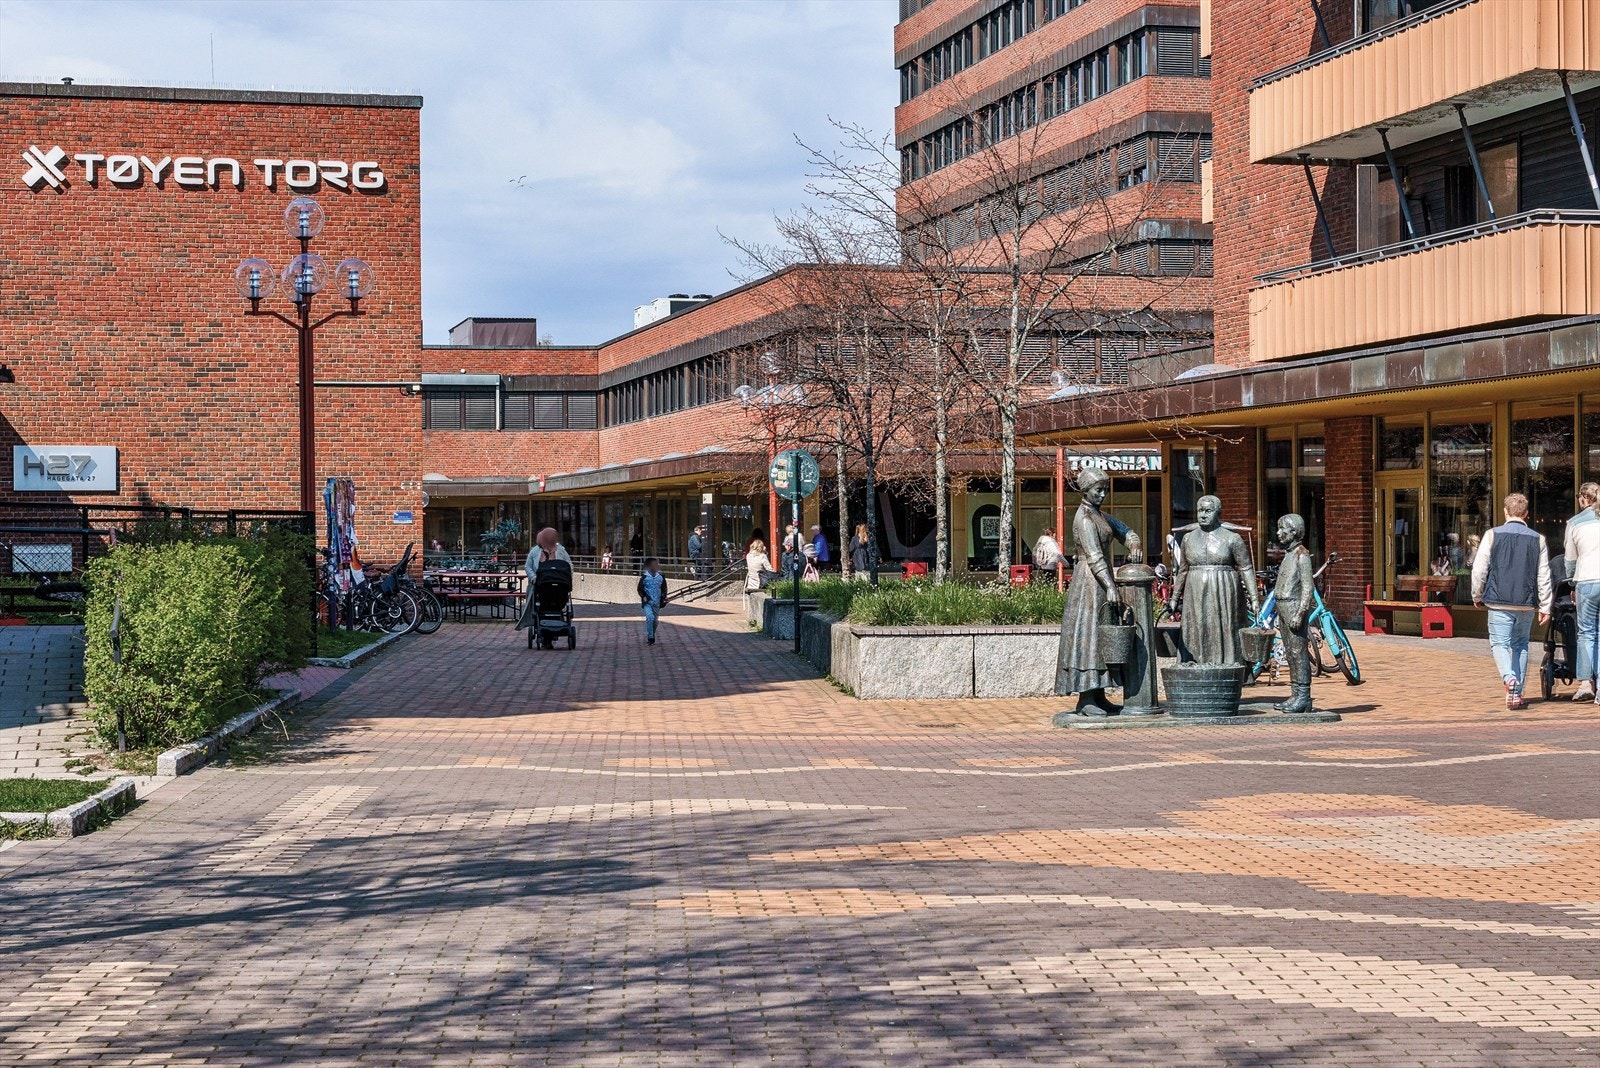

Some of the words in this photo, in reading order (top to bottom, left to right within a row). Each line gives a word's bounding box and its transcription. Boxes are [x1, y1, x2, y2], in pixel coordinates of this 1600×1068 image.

[74, 153, 240, 185] TØYEN
[254, 159, 384, 189] TORG
[23, 455, 92, 476] H27
